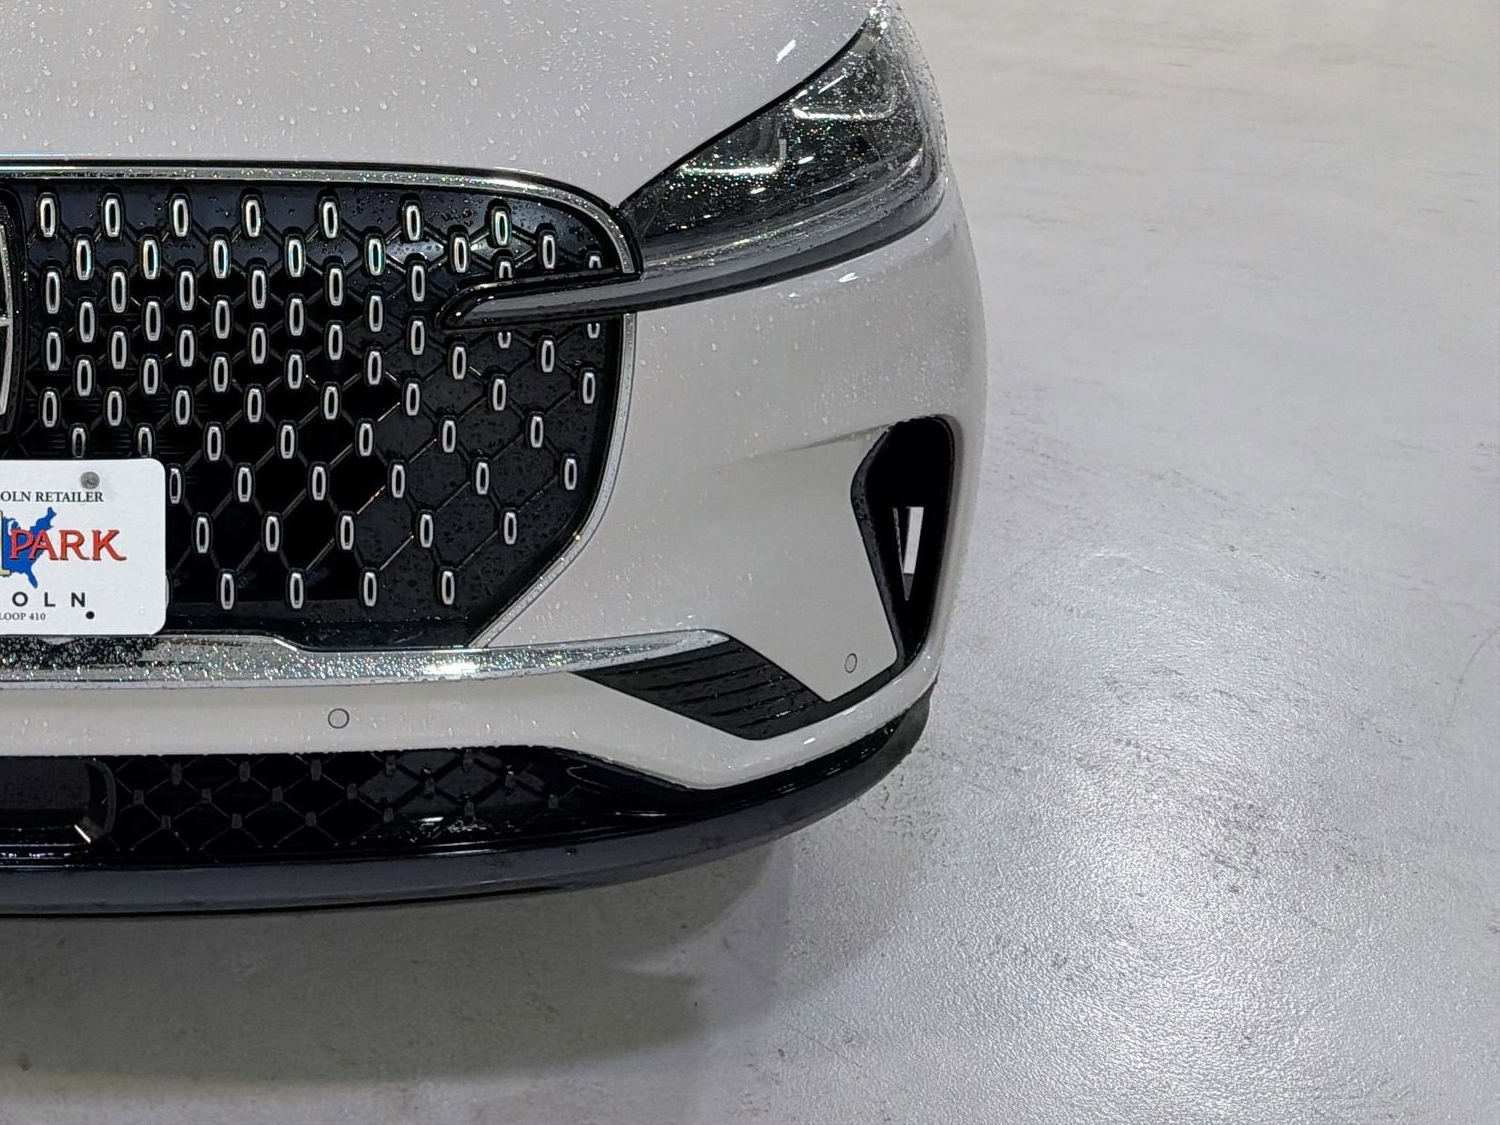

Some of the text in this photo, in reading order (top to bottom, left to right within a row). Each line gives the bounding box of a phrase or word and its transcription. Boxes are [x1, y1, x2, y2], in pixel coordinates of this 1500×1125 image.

[35, 491, 104, 503] RETAILER
[8, 528, 128, 562] PARK
[0, 612, 27, 621] LOOP
[29, 612, 46, 621] 410
